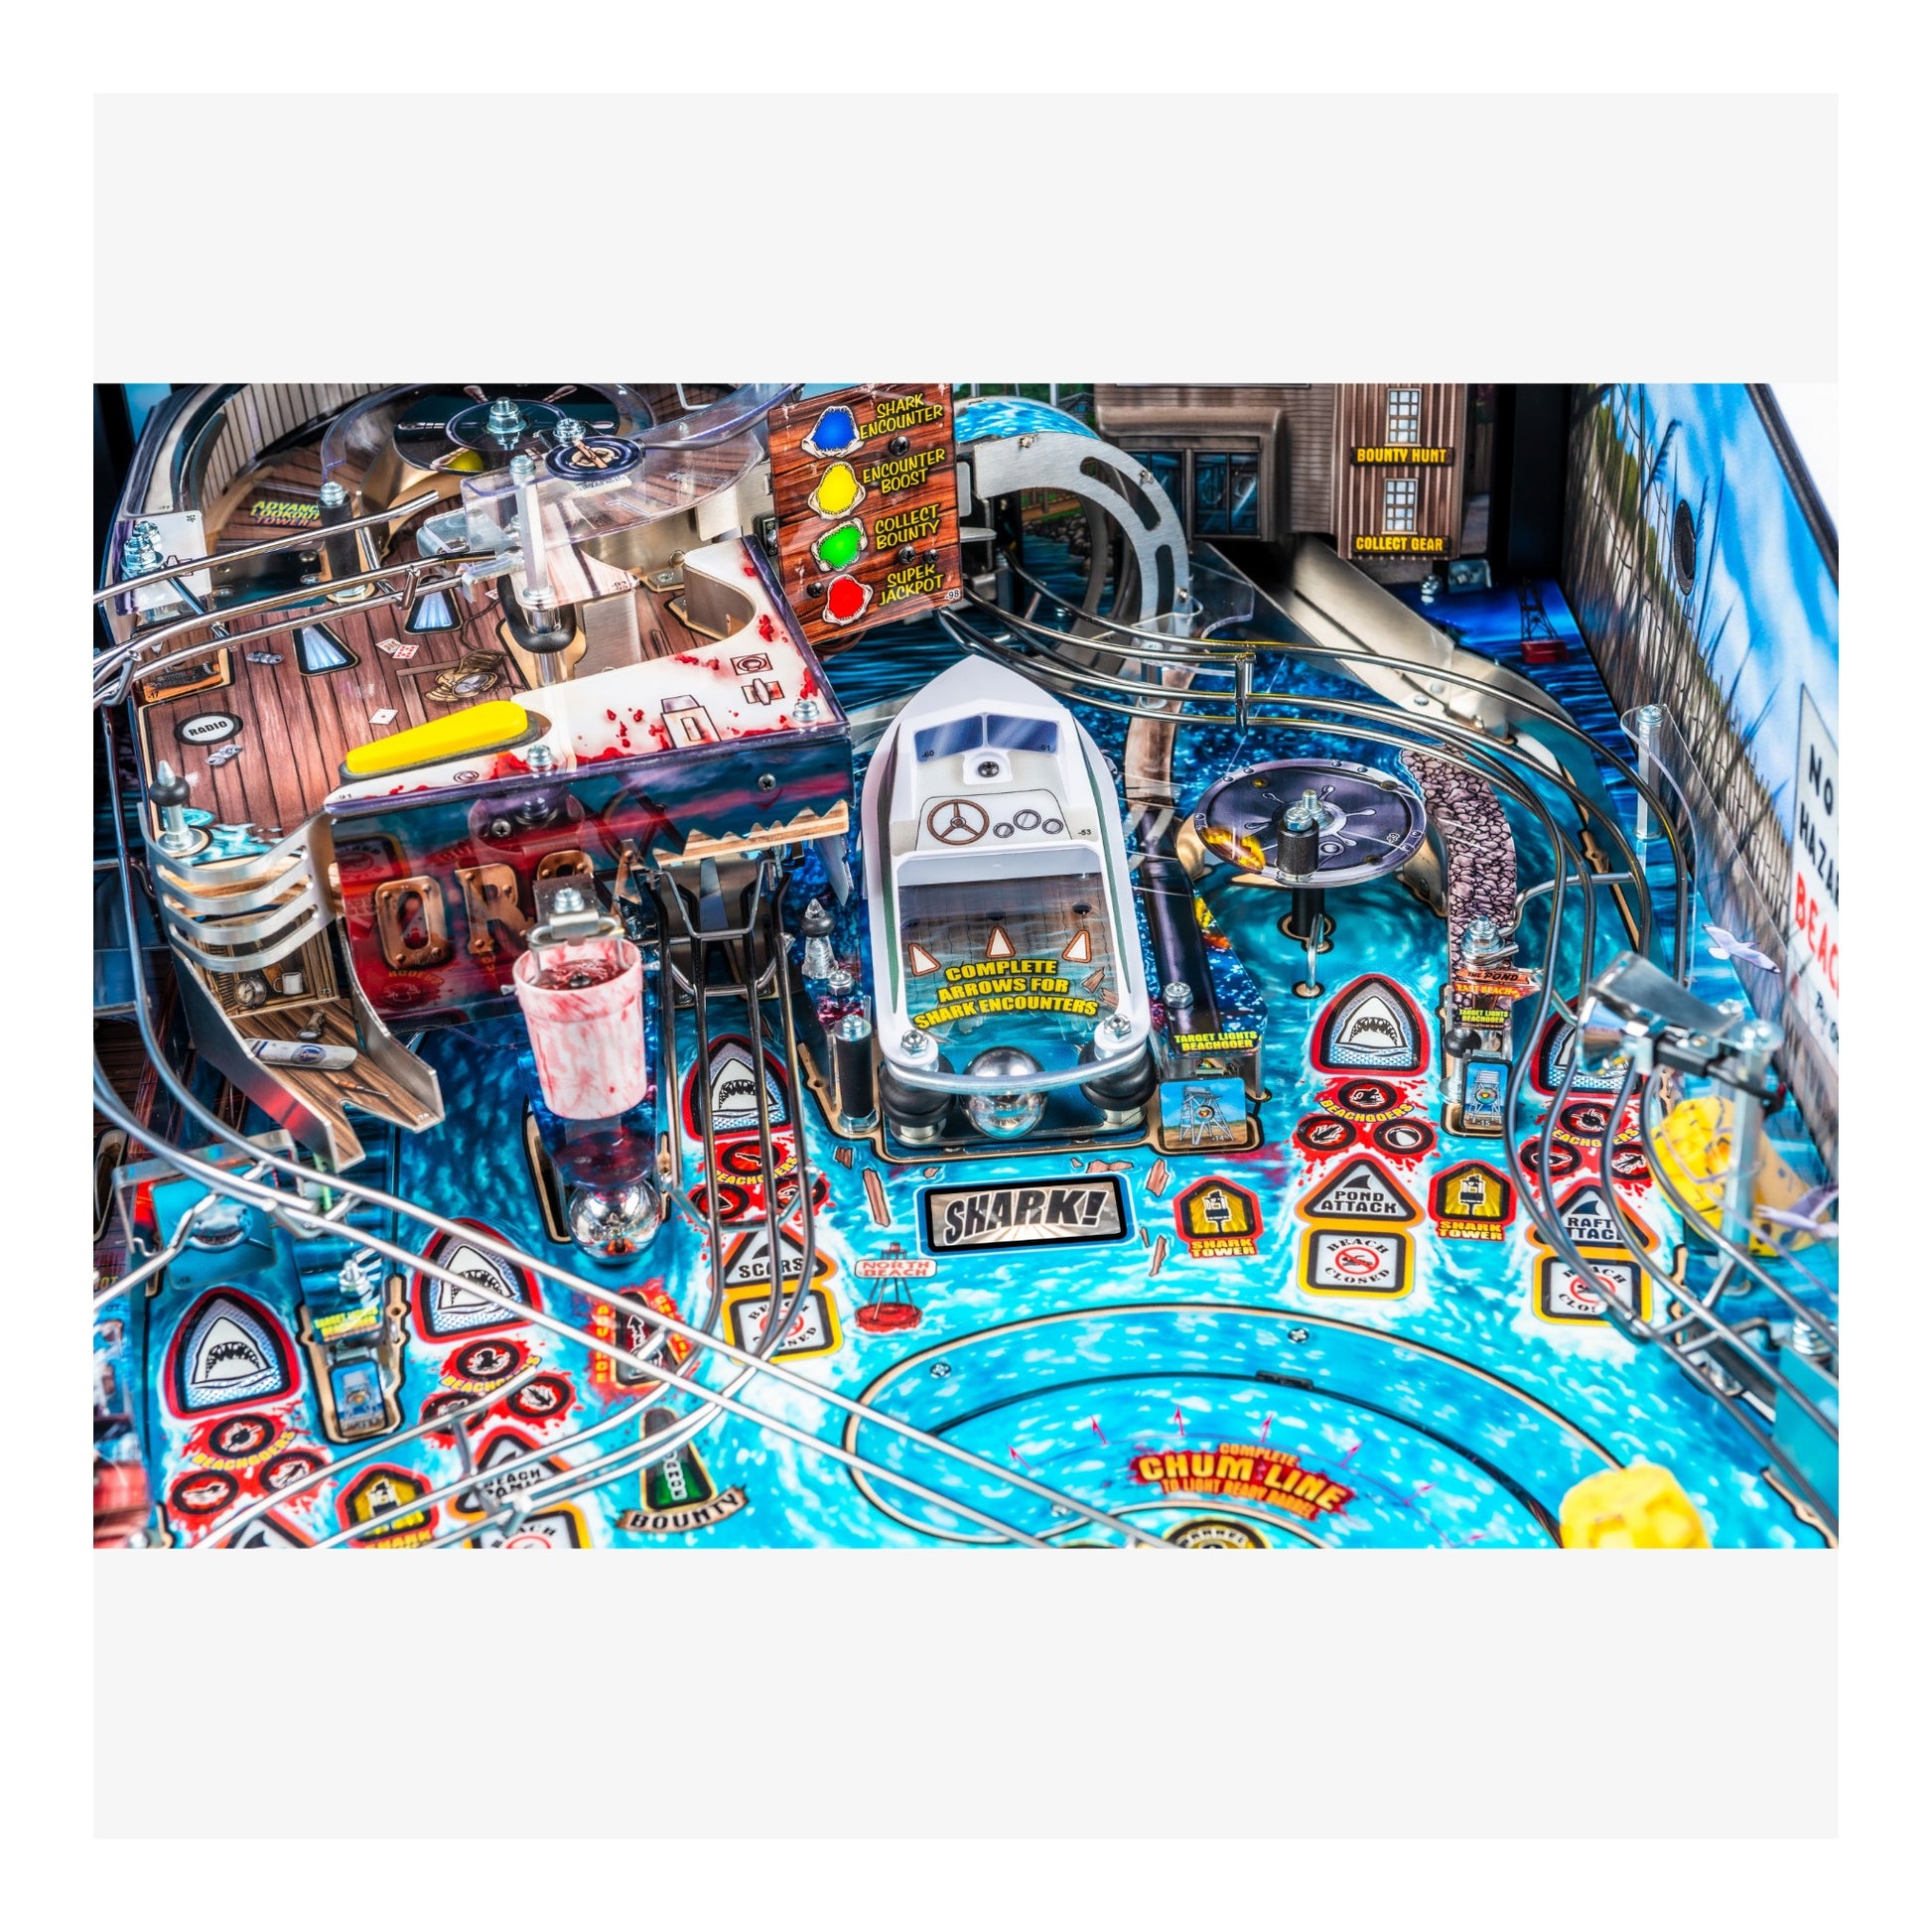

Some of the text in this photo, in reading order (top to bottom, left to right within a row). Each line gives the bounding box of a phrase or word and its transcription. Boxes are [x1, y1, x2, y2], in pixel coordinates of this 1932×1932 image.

[877, 393, 924, 419] SHARK
[859, 404, 943, 440] ENCOUNTER
[1356, 448, 1447, 464] BOUNTY HUNT
[863, 448, 945, 483] ENCOUNTER
[881, 468, 929, 494] BOOST
[253, 500, 320, 513] ADVANC
[875, 503, 939, 534] COLLECT
[877, 520, 940, 550] BOUNTY
[1355, 536, 1444, 552] COLLECT GEAR
[887, 564, 935, 589] SUPER
[879, 574, 944, 606] JACKPOT
[188, 720, 227, 738] RADIO
[1809, 744, 1834, 816] NO
[944, 959, 1058, 982] COMPLETE
[1483, 972, 1519, 981] POND
[937, 977, 1070, 1003] ARROWS FOR
[913, 995, 1099, 1030] SHARK ENCOUNTERS
[1173, 1031, 1258, 1043] TARGET LIGHTS
[1181, 1038, 1254, 1051] BEACHGOER
[1318, 1098, 1414, 1123] BEACHGOERS
[1553, 1127, 1640, 1148] EACHGERS
[1334, 1190, 1385, 1201] POND
[1320, 1200, 1398, 1214] ATTACK
[943, 1189, 1109, 1245] SHARK!
[1567, 1217, 1614, 1229] RAFT
[1438, 1230, 1504, 1241] TOWER
[1439, 1221, 1502, 1232] SHARK
[1565, 1228, 1624, 1240] TTAC
[1191, 1238, 1254, 1249] SHARK
[1191, 1246, 1256, 1257] TOWER
[1326, 1237, 1390, 1255] BEACH
[738, 1259, 805, 1279] SCRS
[862, 1261, 931, 1270] NORTH
[863, 1269, 928, 1278] BEACH
[1324, 1267, 1391, 1285] CLOSED
[1219, 1443, 1299, 1467] COMPLETE
[1139, 1453, 1348, 1510] CHUM LINE
[1162, 1478, 1178, 1493] TO
[1182, 1478, 1221, 1494] LIGHT
[629, 1492, 739, 1529] BOUNTY
